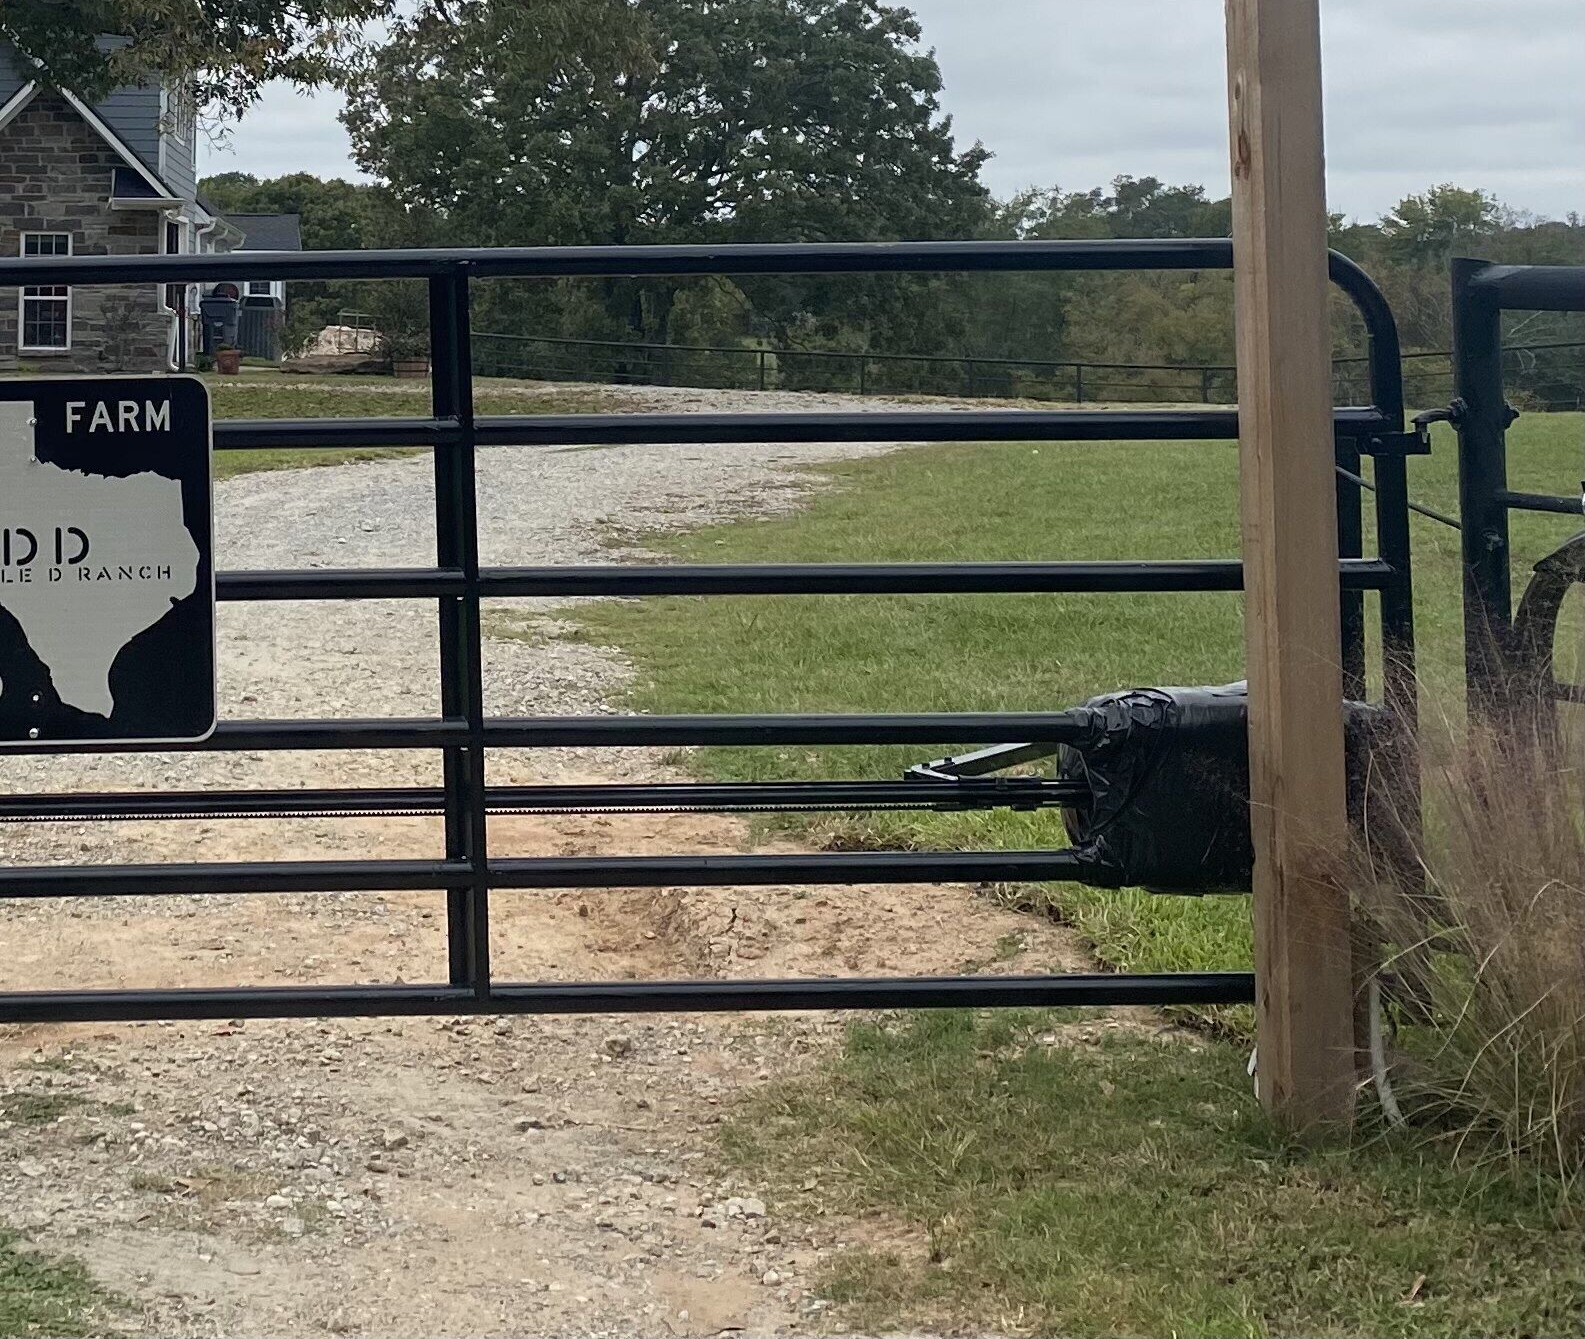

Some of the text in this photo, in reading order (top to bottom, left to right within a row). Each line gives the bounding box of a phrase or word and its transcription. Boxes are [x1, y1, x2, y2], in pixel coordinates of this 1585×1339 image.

[66, 399, 172, 434] FARM
[48, 567, 62, 582] D
[77, 564, 172, 582] RANCH
